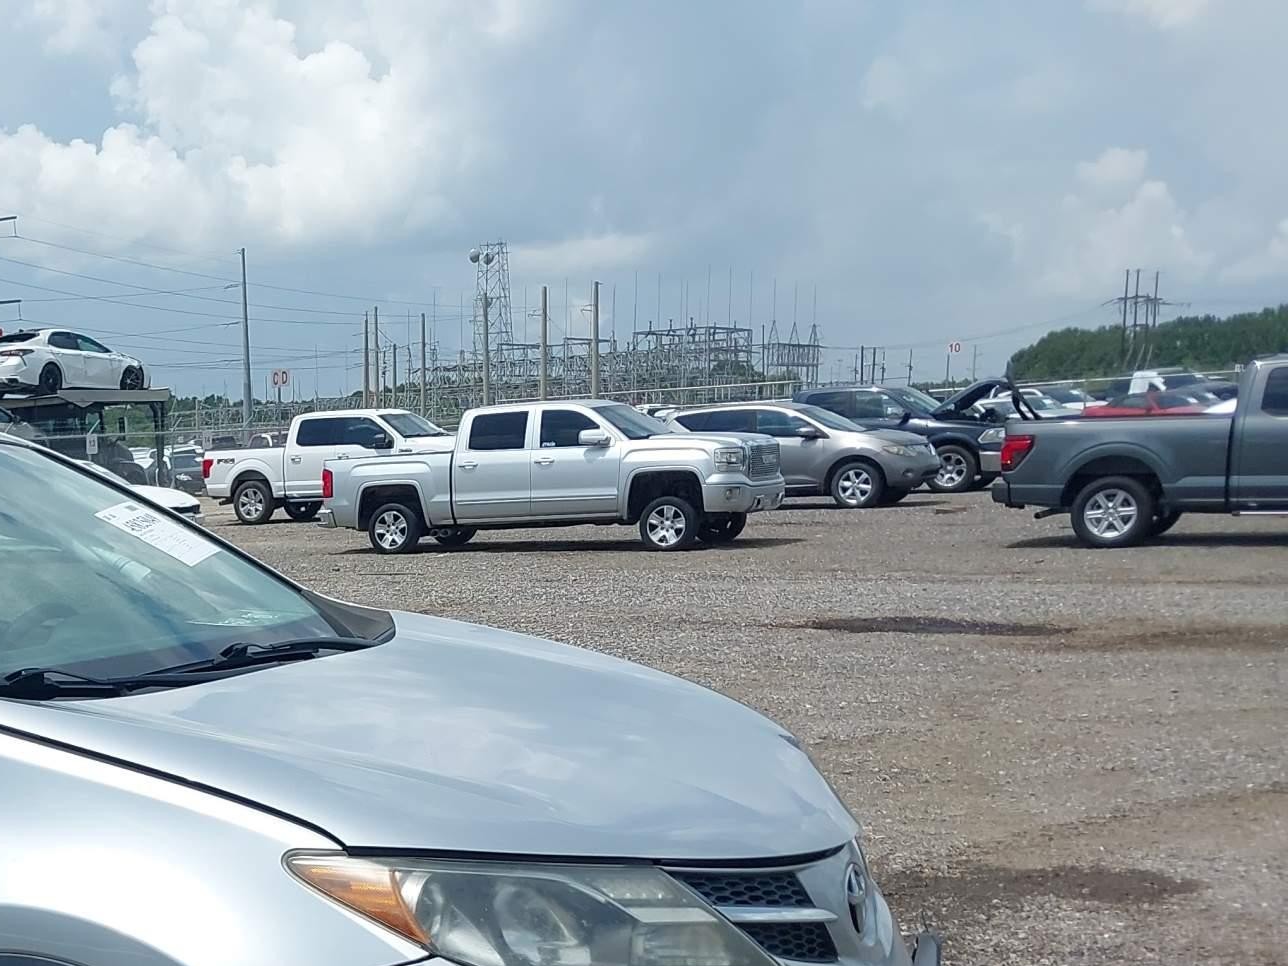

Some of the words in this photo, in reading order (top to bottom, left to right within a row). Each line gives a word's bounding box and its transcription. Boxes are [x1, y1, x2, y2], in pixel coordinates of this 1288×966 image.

[949, 342, 961, 353] 10
[273, 372, 279, 386] C
[281, 371, 288, 385] D
